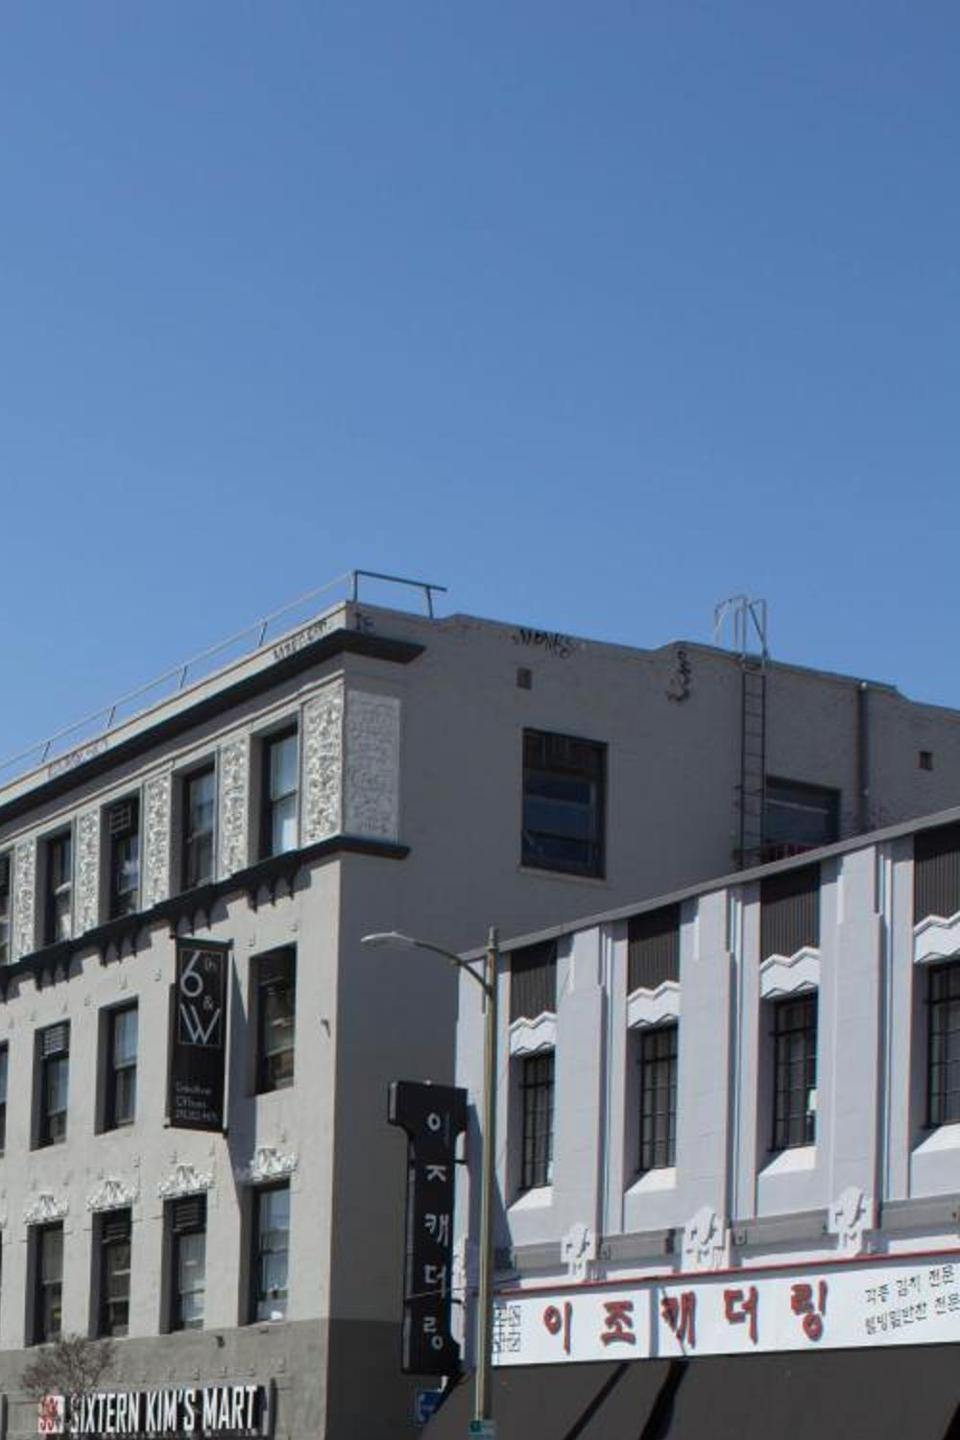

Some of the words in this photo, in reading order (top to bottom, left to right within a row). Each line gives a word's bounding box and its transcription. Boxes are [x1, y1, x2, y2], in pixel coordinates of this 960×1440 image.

[179, 1002, 222, 1044] W
[202, 995, 215, 1011] &
[70, 1391, 140, 1434] SIXTERN
[145, 1388, 196, 1433] KIM'S
[202, 1385, 259, 1431] MART
